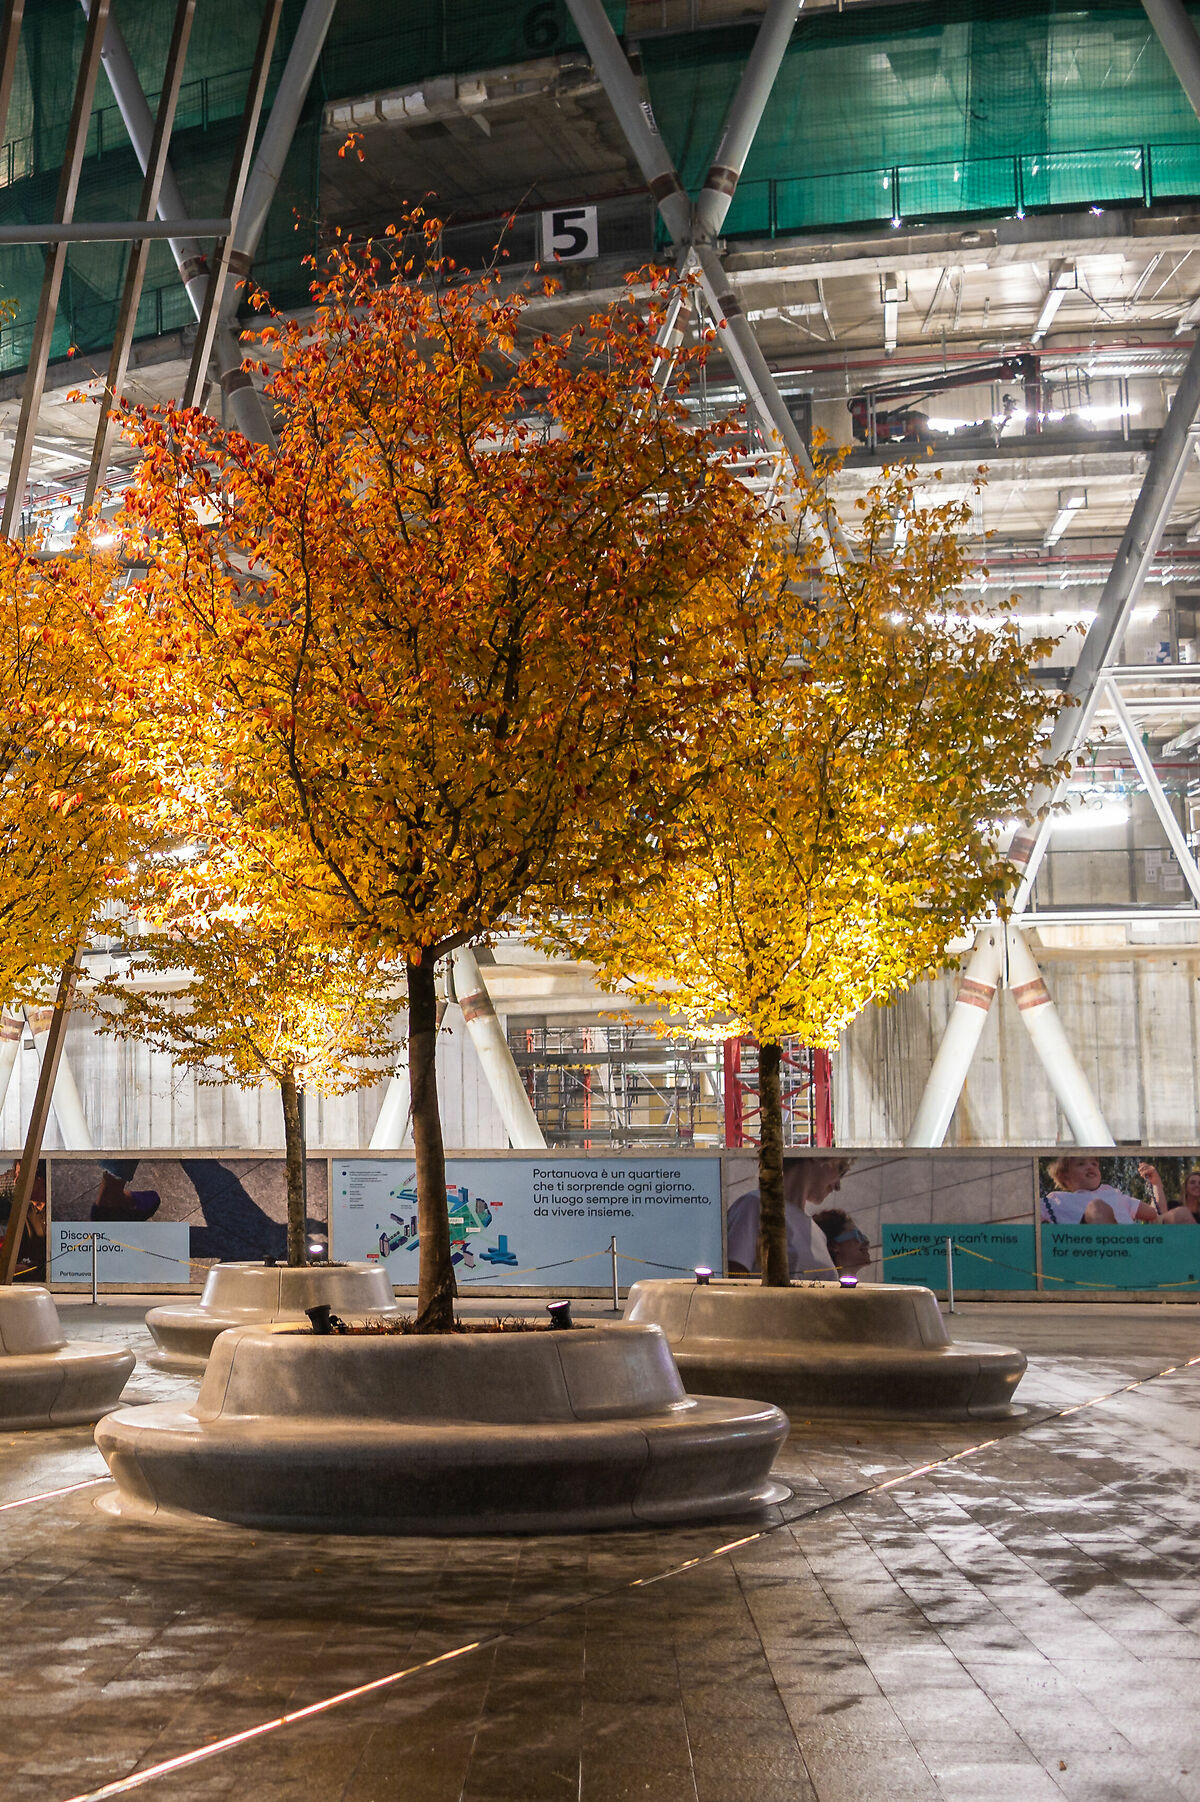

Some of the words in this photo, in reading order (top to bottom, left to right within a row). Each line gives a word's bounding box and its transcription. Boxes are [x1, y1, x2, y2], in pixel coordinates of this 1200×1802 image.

[552, 210, 588, 257] 5
[533, 1168, 598, 1179] Portanuova
[601, 1169, 608, 1179] è
[611, 1171, 625, 1179] un
[628, 1169, 681, 1180] quartiere
[533, 1181, 554, 1191] che
[557, 1181, 564, 1191] ti
[567, 1181, 625, 1193] sorprende
[627, 1182, 652, 1194] ogni
[655, 1182, 695, 1194] giorno.
[533, 1194, 549, 1204] Un
[551, 1194, 584, 1206] luogo
[586, 1196, 629, 1205] sempre
[631, 1195, 642, 1204] in
[644, 1195, 712, 1206] movimento,
[533, 1207, 549, 1217] da
[551, 1207, 585, 1217] vivere
[587, 1207, 634, 1217] insieme.
[891, 1232, 931, 1243] Where
[958, 1232, 988, 1243] can't
[991, 1234, 1018, 1244] miss
[1052, 1233, 1093, 1244] Where
[1096, 1235, 1140, 1246] spaces
[1143, 1235, 1164, 1244] are
[1053, 1247, 1069, 1257] for
[1072, 1248, 1131, 1259] everyone.
